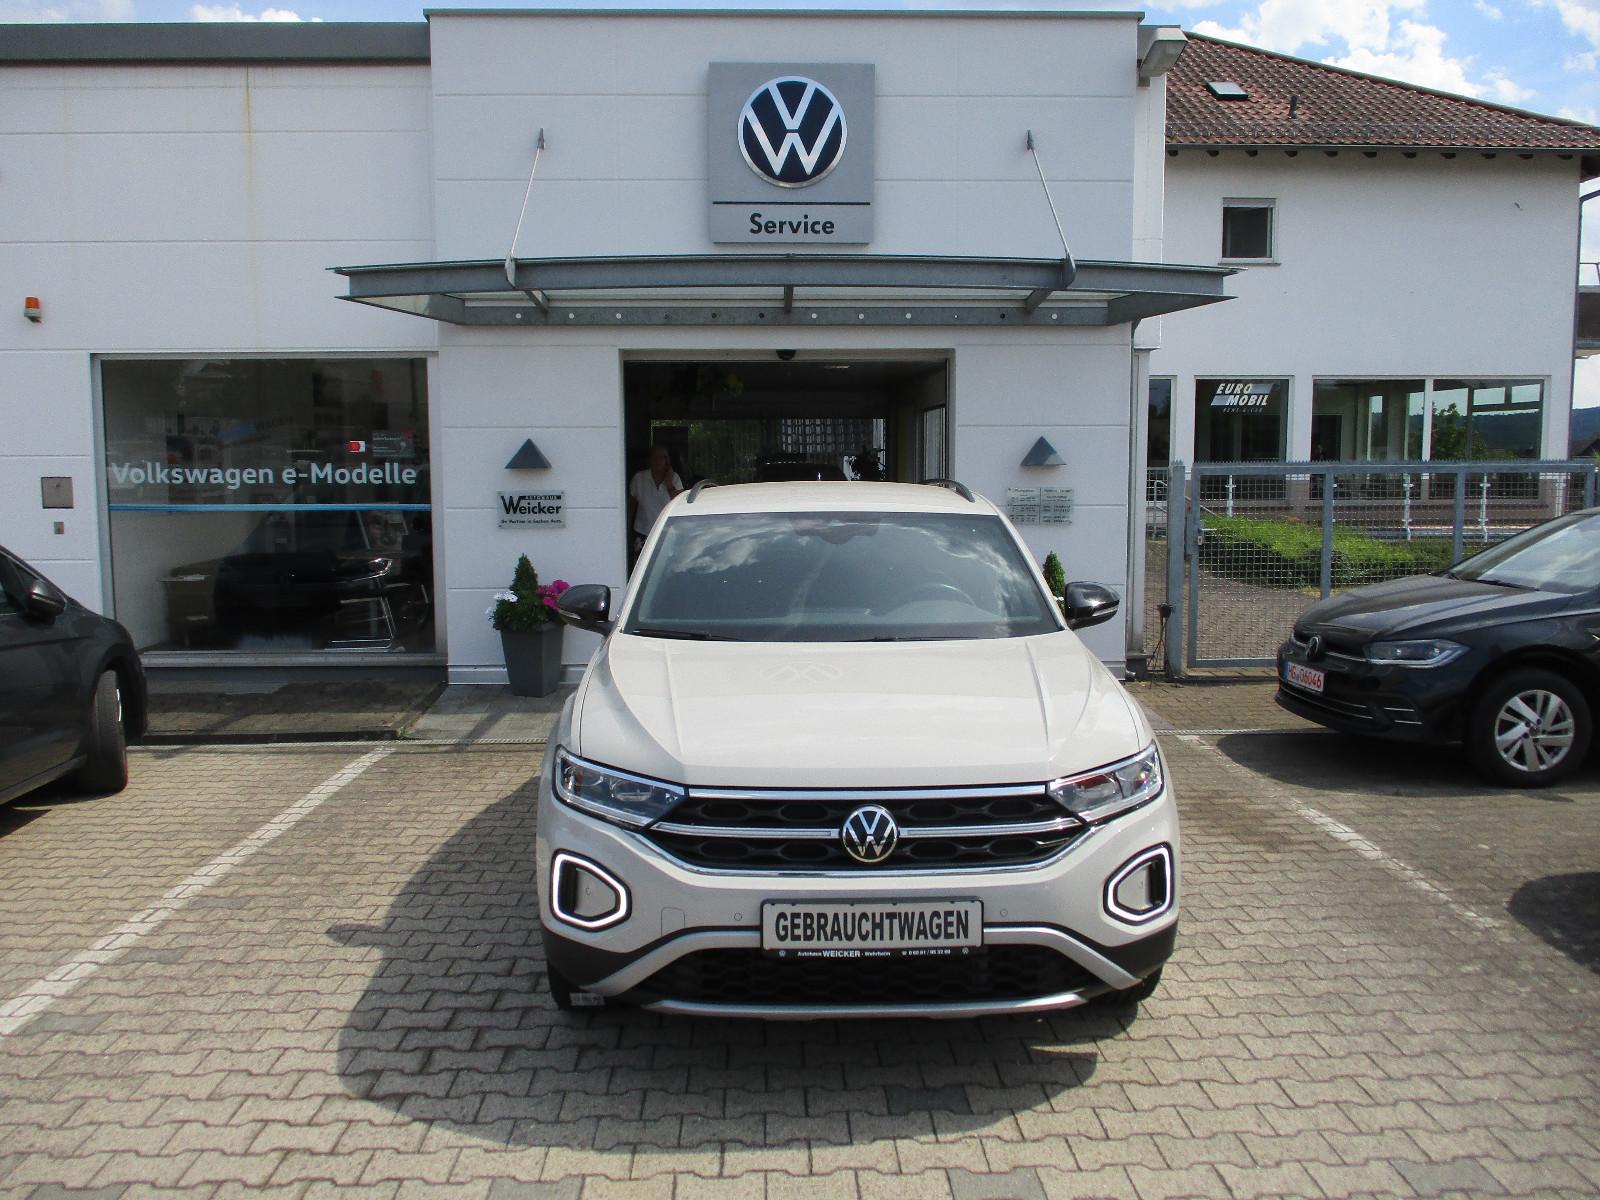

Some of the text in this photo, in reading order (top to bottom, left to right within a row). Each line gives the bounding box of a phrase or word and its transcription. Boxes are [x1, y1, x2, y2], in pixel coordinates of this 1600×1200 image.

[737, 75, 848, 189] VW
[749, 212, 835, 235] Service
[1216, 383, 1253, 395] EURO
[1225, 394, 1269, 406] MOBIL
[110, 461, 417, 490] Volkswagen e-Modelle
[500, 495, 562, 515] Weicker
[775, 910, 969, 942] GEBRAUCHTWAGEN
[822, 950, 861, 958] WEICKER
